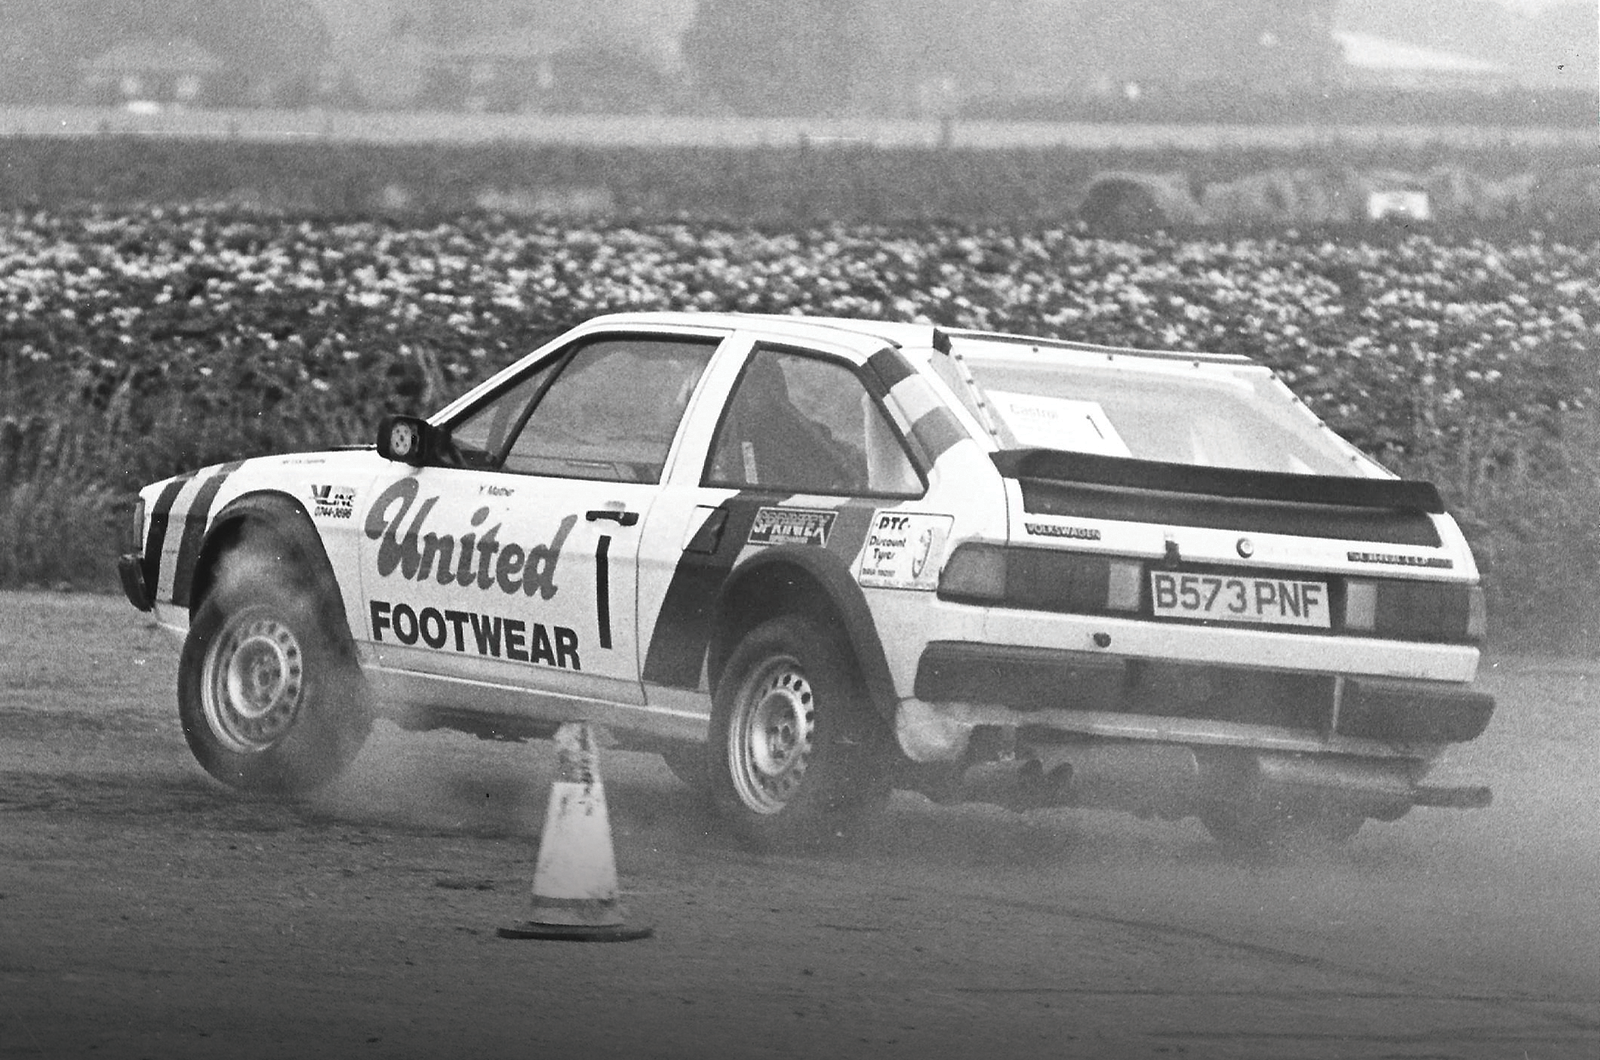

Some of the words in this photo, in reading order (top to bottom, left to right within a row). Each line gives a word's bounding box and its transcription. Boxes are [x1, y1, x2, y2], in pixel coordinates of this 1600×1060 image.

[364, 477, 578, 600] United
[869, 535, 907, 548] Discount
[1024, 522, 1101, 541] VOLKSWAGEN
[1154, 574, 1248, 614] B573
[1254, 580, 1322, 618] PNF
[370, 600, 581, 670] FOOTWEAR
